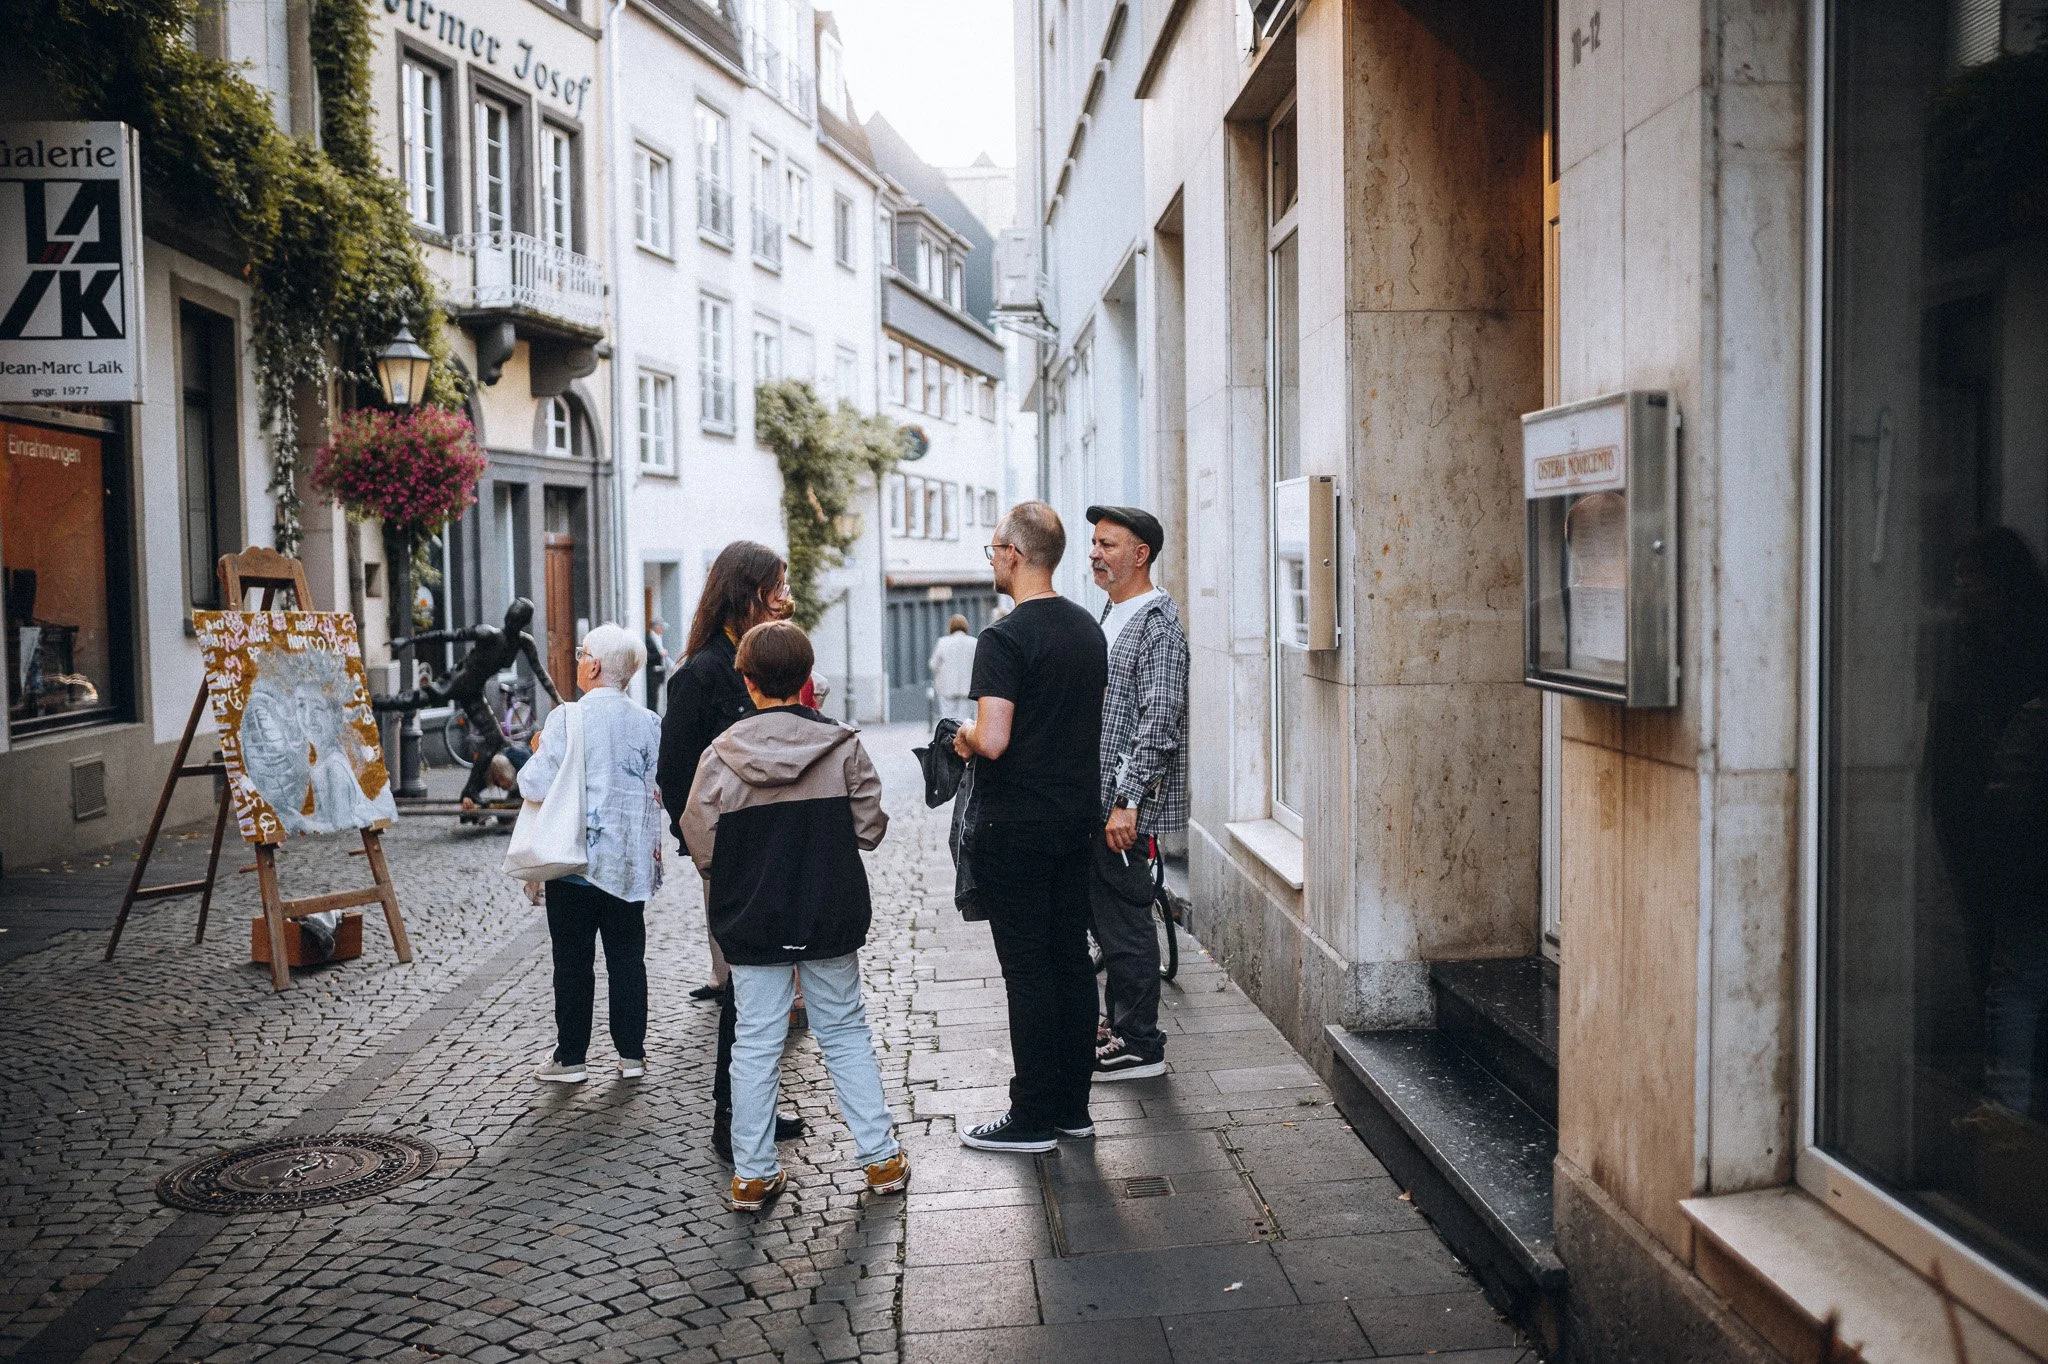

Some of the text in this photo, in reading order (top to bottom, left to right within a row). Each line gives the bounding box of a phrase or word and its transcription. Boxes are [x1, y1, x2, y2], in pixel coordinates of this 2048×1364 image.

[514, 38, 591, 118] Josef
[0, 360, 123, 375] Jean-Marc Laik
[32, 386, 89, 397] gegr. 1977
[8, 434, 81, 467] Einrahmungen
